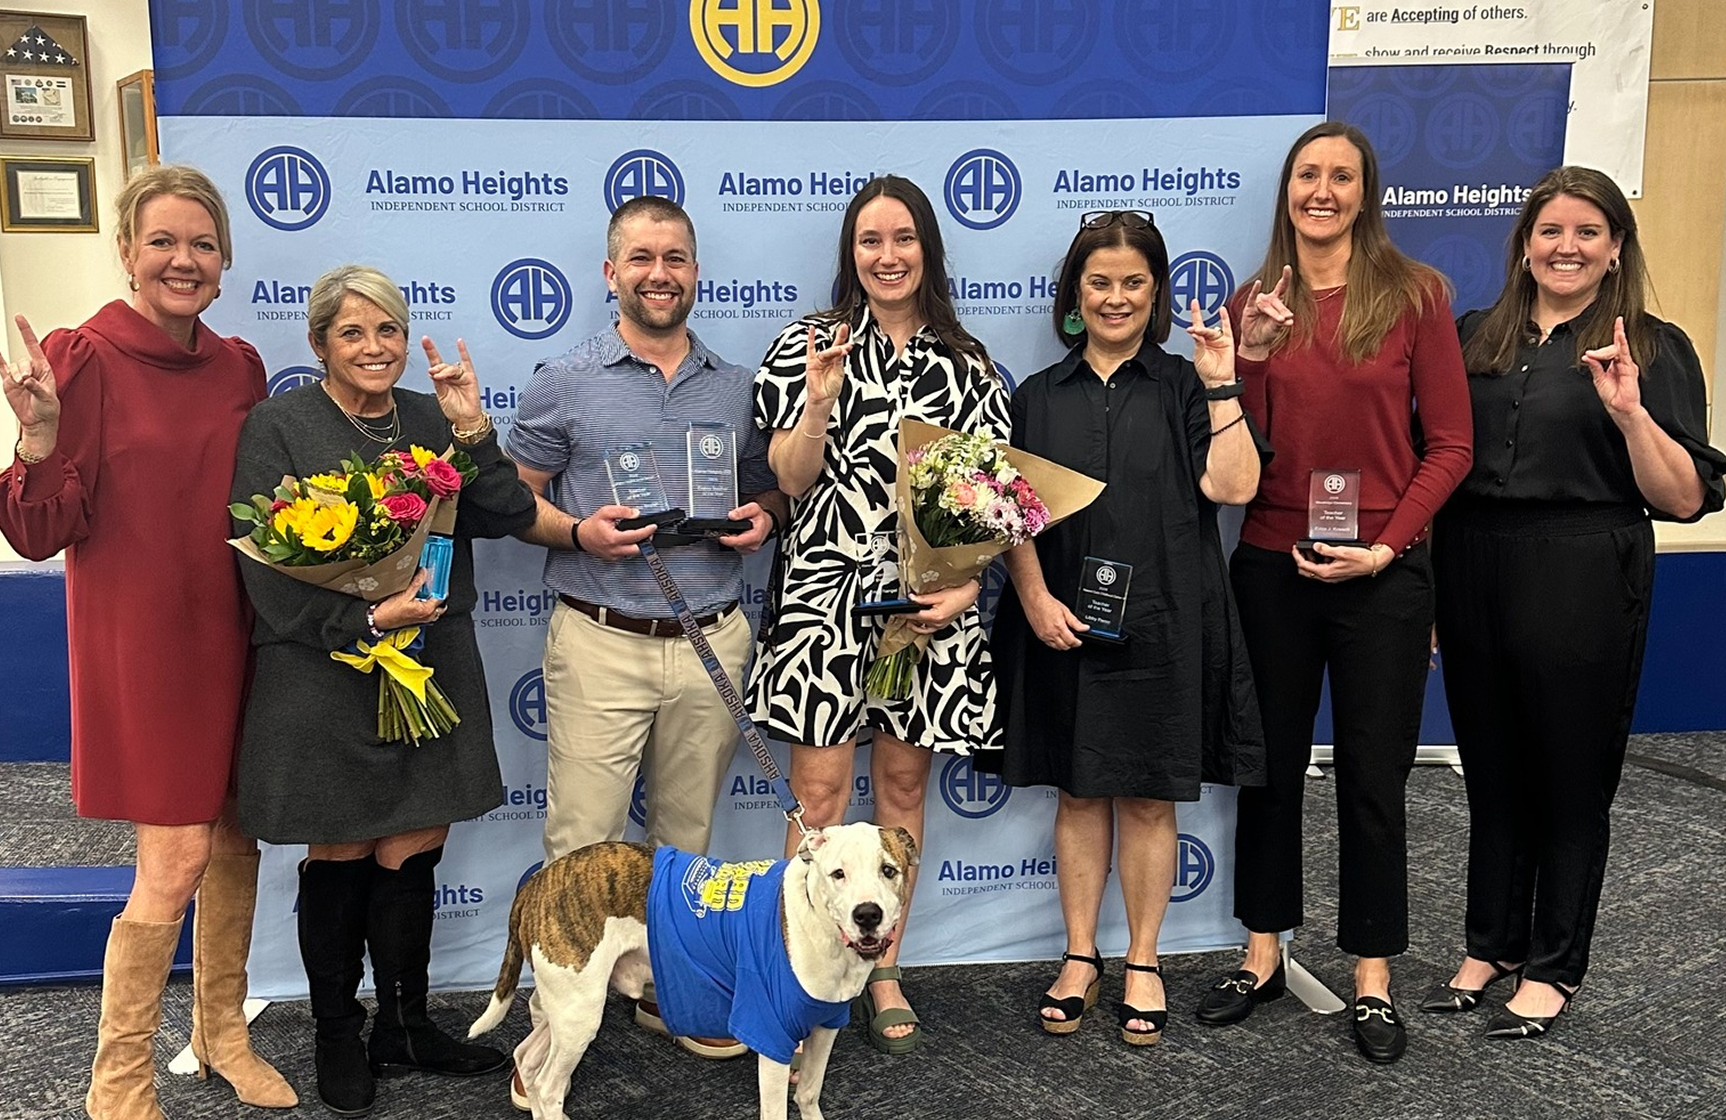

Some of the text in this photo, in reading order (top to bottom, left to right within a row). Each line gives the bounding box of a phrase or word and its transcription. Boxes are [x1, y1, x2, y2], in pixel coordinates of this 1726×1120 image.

[1366, 11, 1388, 23] are
[1390, 6, 1460, 24] Accepting
[1462, 5, 1478, 20] of
[1480, 4, 1528, 20] others.
[1543, 42, 1596, 60] through
[254, 154, 322, 217] AH
[365, 169, 569, 200] Alamo Heights
[718, 171, 875, 196] Alamo Heig
[951, 157, 1015, 216] AH
[1053, 167, 1241, 196] Alamo Heights
[371, 201, 566, 212] INDEPENDENT SCHOOL DISTRICT
[1056, 195, 1237, 210] INDEPENDENT SCHOOL DISTRICT
[1381, 184, 1533, 208] Alamo Heights
[722, 202, 804, 213] INDEPENDENT
[1445, 208, 1483, 218] SCHOOL
[499, 267, 565, 326] AH
[697, 279, 798, 308] Heights
[946, 277, 1023, 300] Alamo
[257, 311, 453, 320] INDEPEN STRICT
[693, 308, 795, 319] SCHOOL DISTRICT
[957, 304, 1055, 316] DEPENDENT SCHO
[650, 557, 681, 601] AHSOKA
[483, 589, 554, 617] Heigh
[480, 617, 527, 628] SCHOOL
[683, 614, 712, 661] AHSOKA
[518, 676, 548, 728] A
[715, 670, 747, 720] AHSOKA
[749, 732, 781, 781] AHSOKA
[730, 775, 778, 796] Ala
[488, 811, 534, 822] SCHOOL
[734, 800, 784, 811] INDEPEN
[938, 860, 1014, 882] Alamo
[941, 880, 1058, 896] INDEPENDENT SCHOOL
